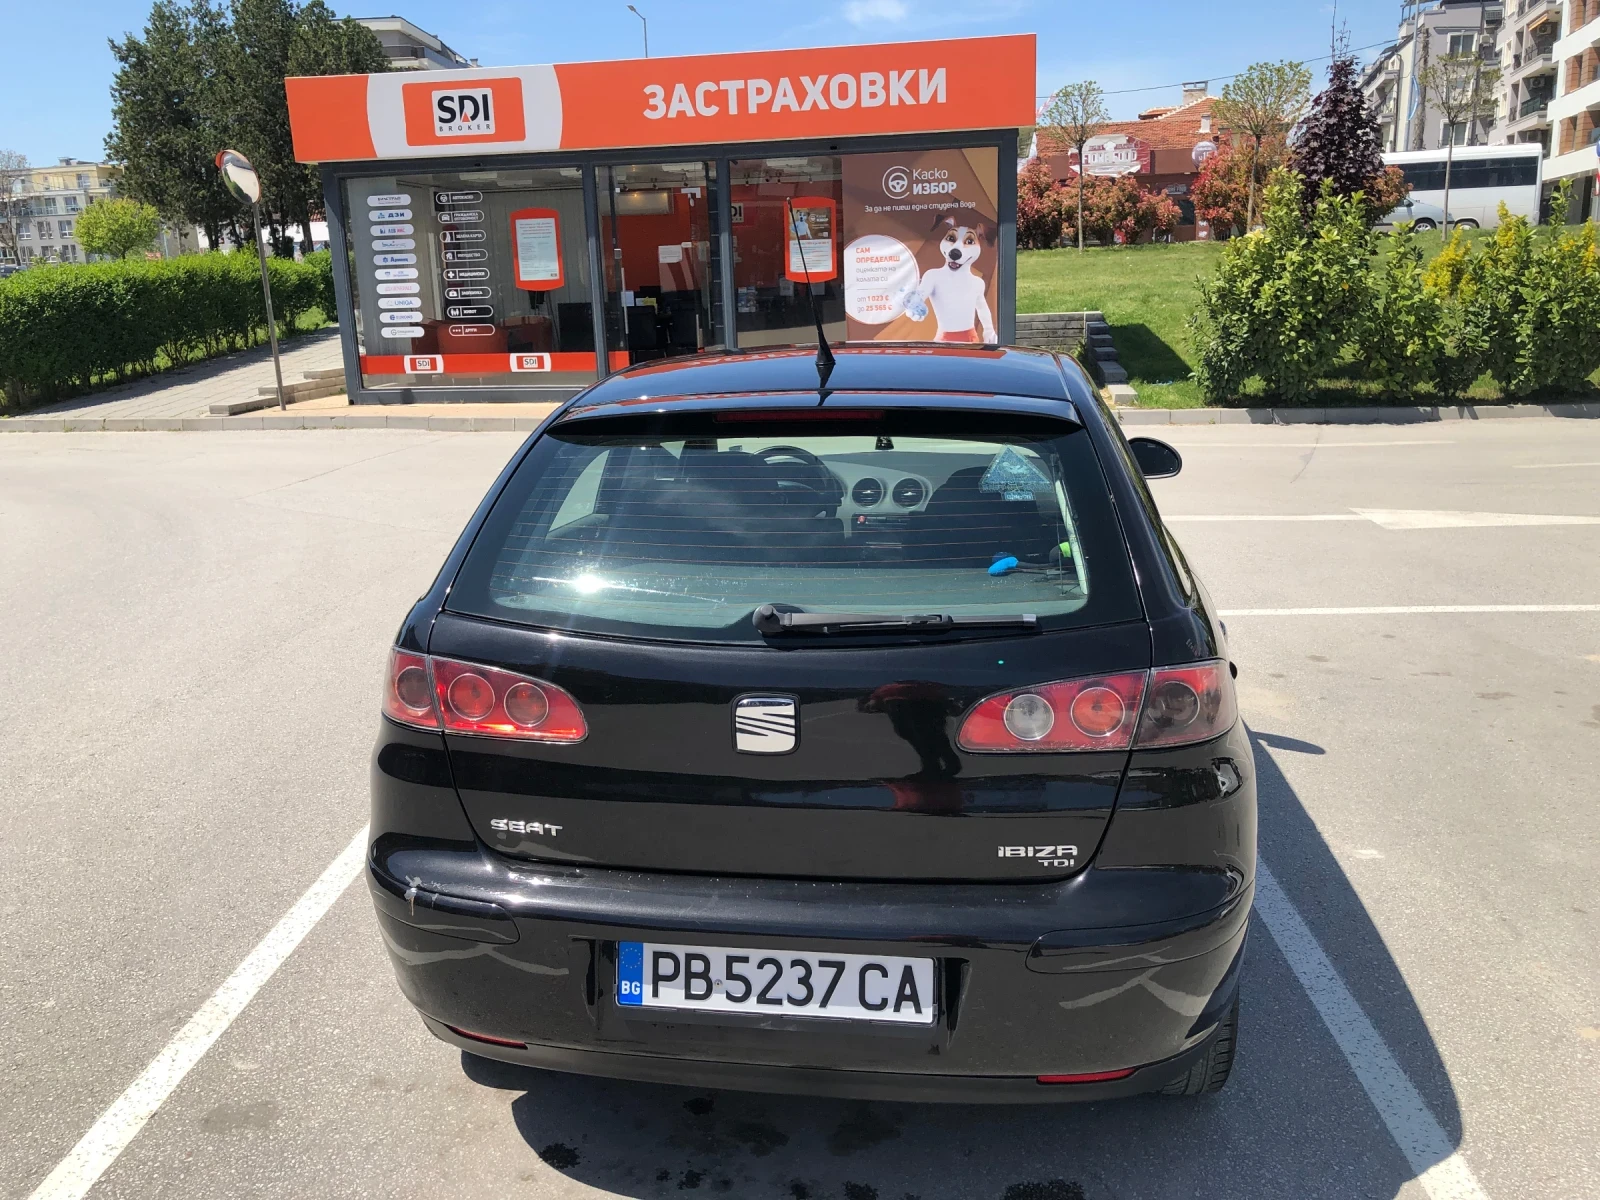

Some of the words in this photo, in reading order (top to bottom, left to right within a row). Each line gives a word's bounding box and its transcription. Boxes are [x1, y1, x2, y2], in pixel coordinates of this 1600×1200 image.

[643, 68, 946, 120] ЗАСТРАХОВКИ
[437, 93, 490, 123] SDI
[439, 124, 491, 132] BROKER
[912, 168, 948, 180] Каско
[912, 181, 957, 195] ИЗБОР
[873, 205, 882, 213] да
[911, 204, 928, 212] една
[928, 203, 959, 211] студена
[959, 201, 976, 209] вода
[490, 818, 563, 836] SEAT
[997, 845, 1078, 857] IBIZA
[1037, 858, 1075, 867] TDI
[621, 980, 641, 995] BG
[651, 951, 714, 1001] PB
[725, 954, 846, 1008] 5237
[858, 963, 923, 1014] CA
